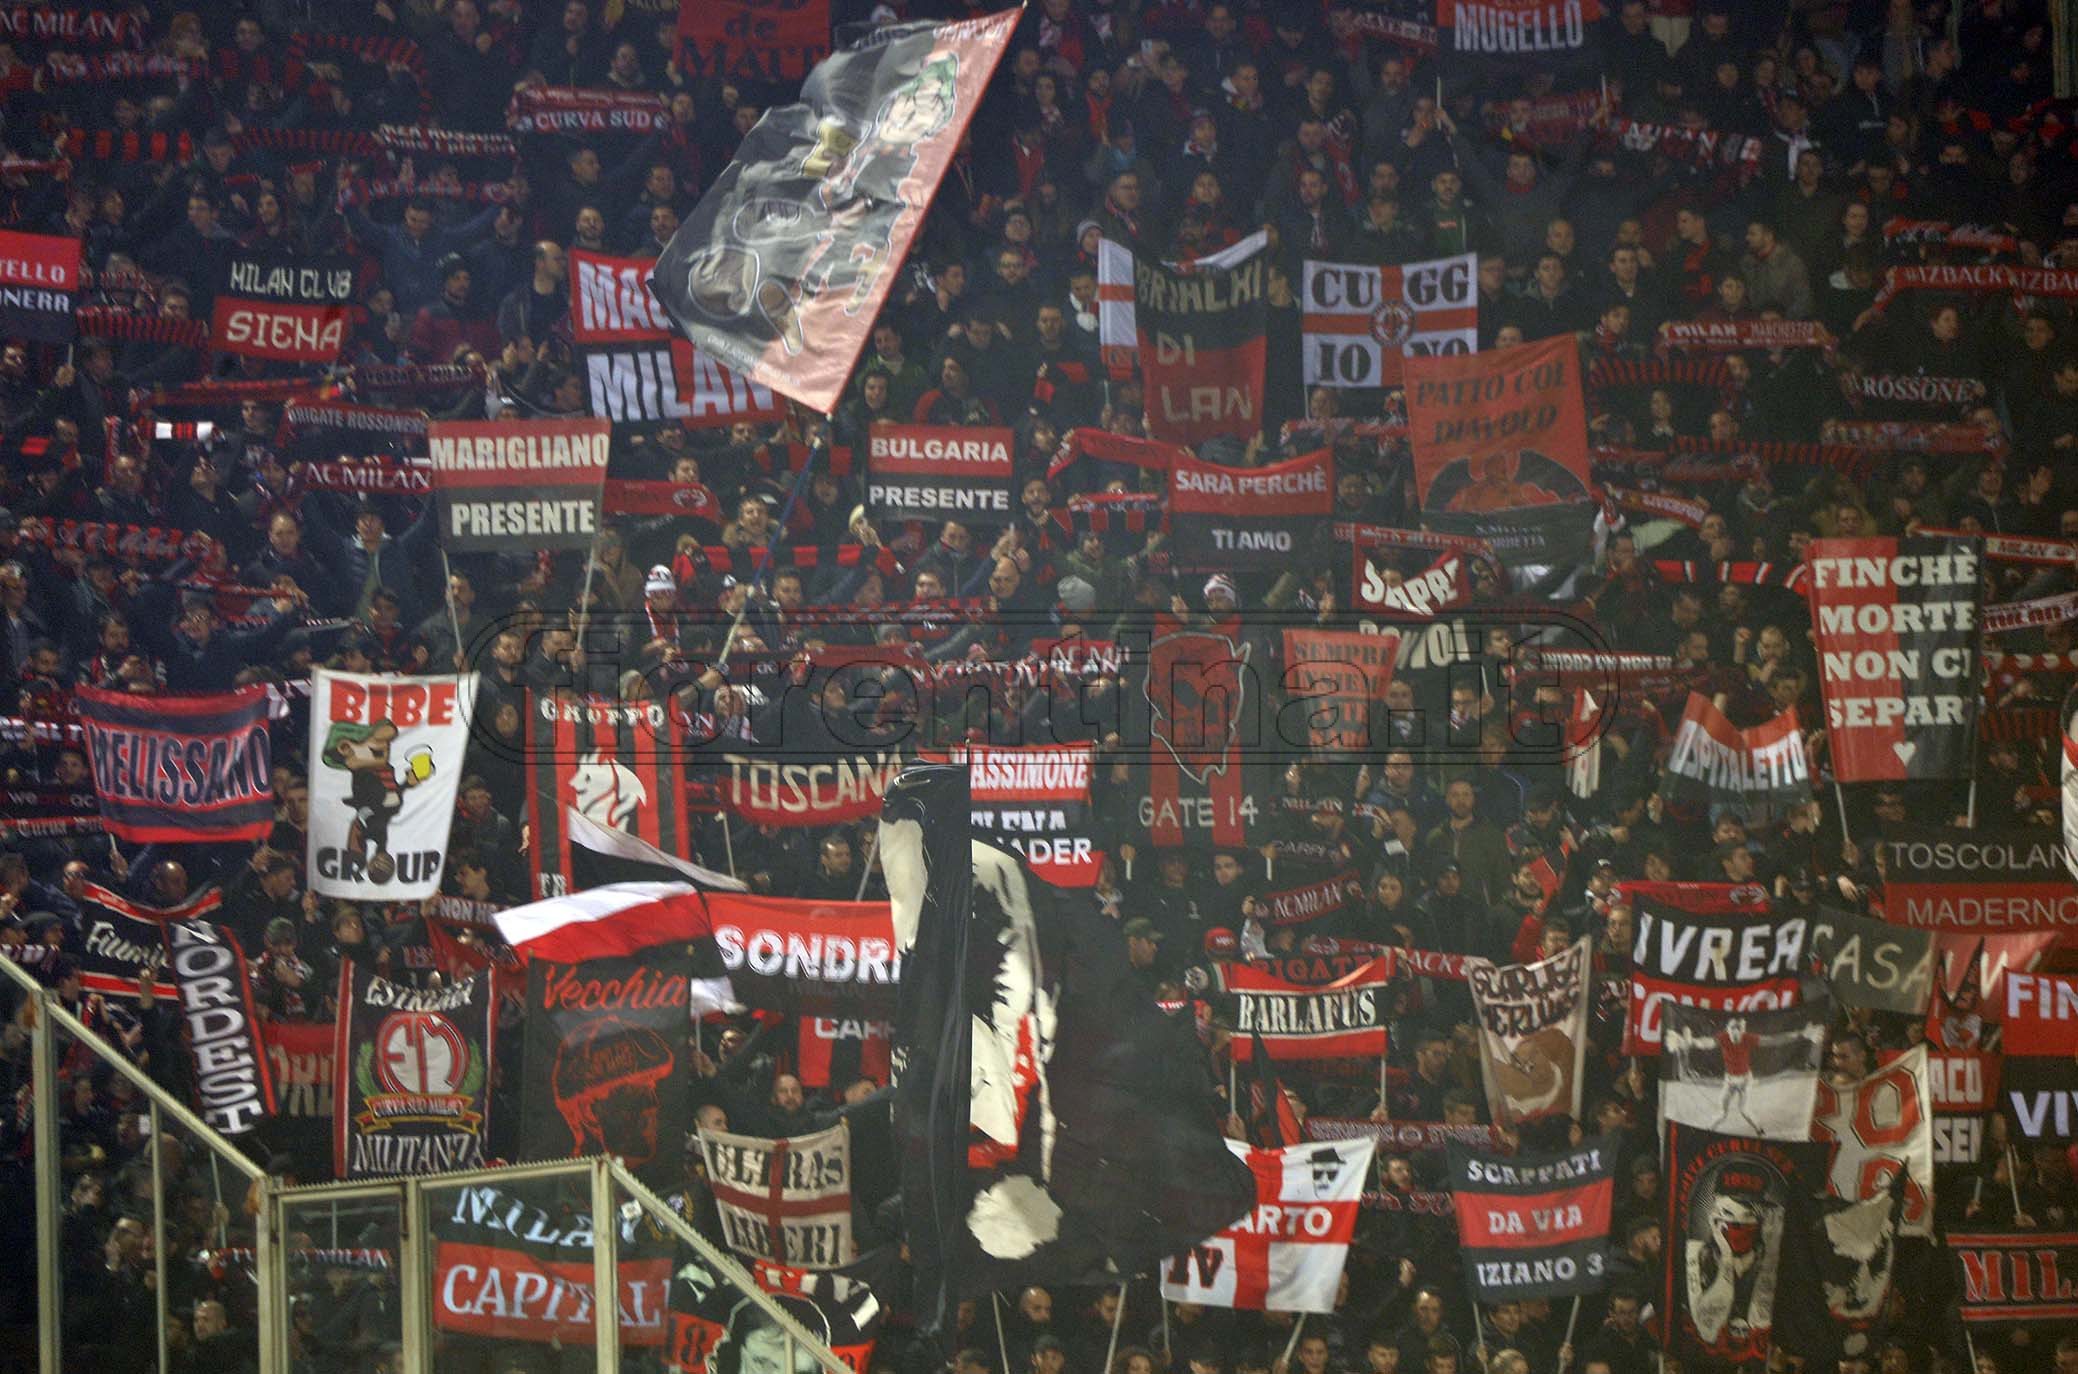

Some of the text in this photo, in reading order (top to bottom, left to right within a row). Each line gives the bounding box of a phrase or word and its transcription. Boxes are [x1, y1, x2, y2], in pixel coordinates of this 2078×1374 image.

[1454, 0, 1585, 53] MUGELLO
[535, 111, 650, 132] CURVA SUD
[226, 310, 344, 351] SIENA
[586, 350, 774, 424] MILAN
[431, 431, 608, 473] MARIGLIANO
[871, 437, 1009, 464] BULGARIA
[869, 485, 1010, 511] PRESENTE
[452, 499, 594, 537] PRESENTE
[1817, 600, 1977, 637] MORTE
[1822, 646, 1972, 682] NON CI
[328, 681, 456, 726] BIBE
[541, 696, 664, 731] GRUPPO
[1138, 795, 1216, 829] GATE
[1632, 910, 1807, 984] IVREA
[543, 965, 688, 1012] Vecchia
[2009, 1090, 2078, 1138] VI
[1487, 1204, 1584, 1235] DA VIA
